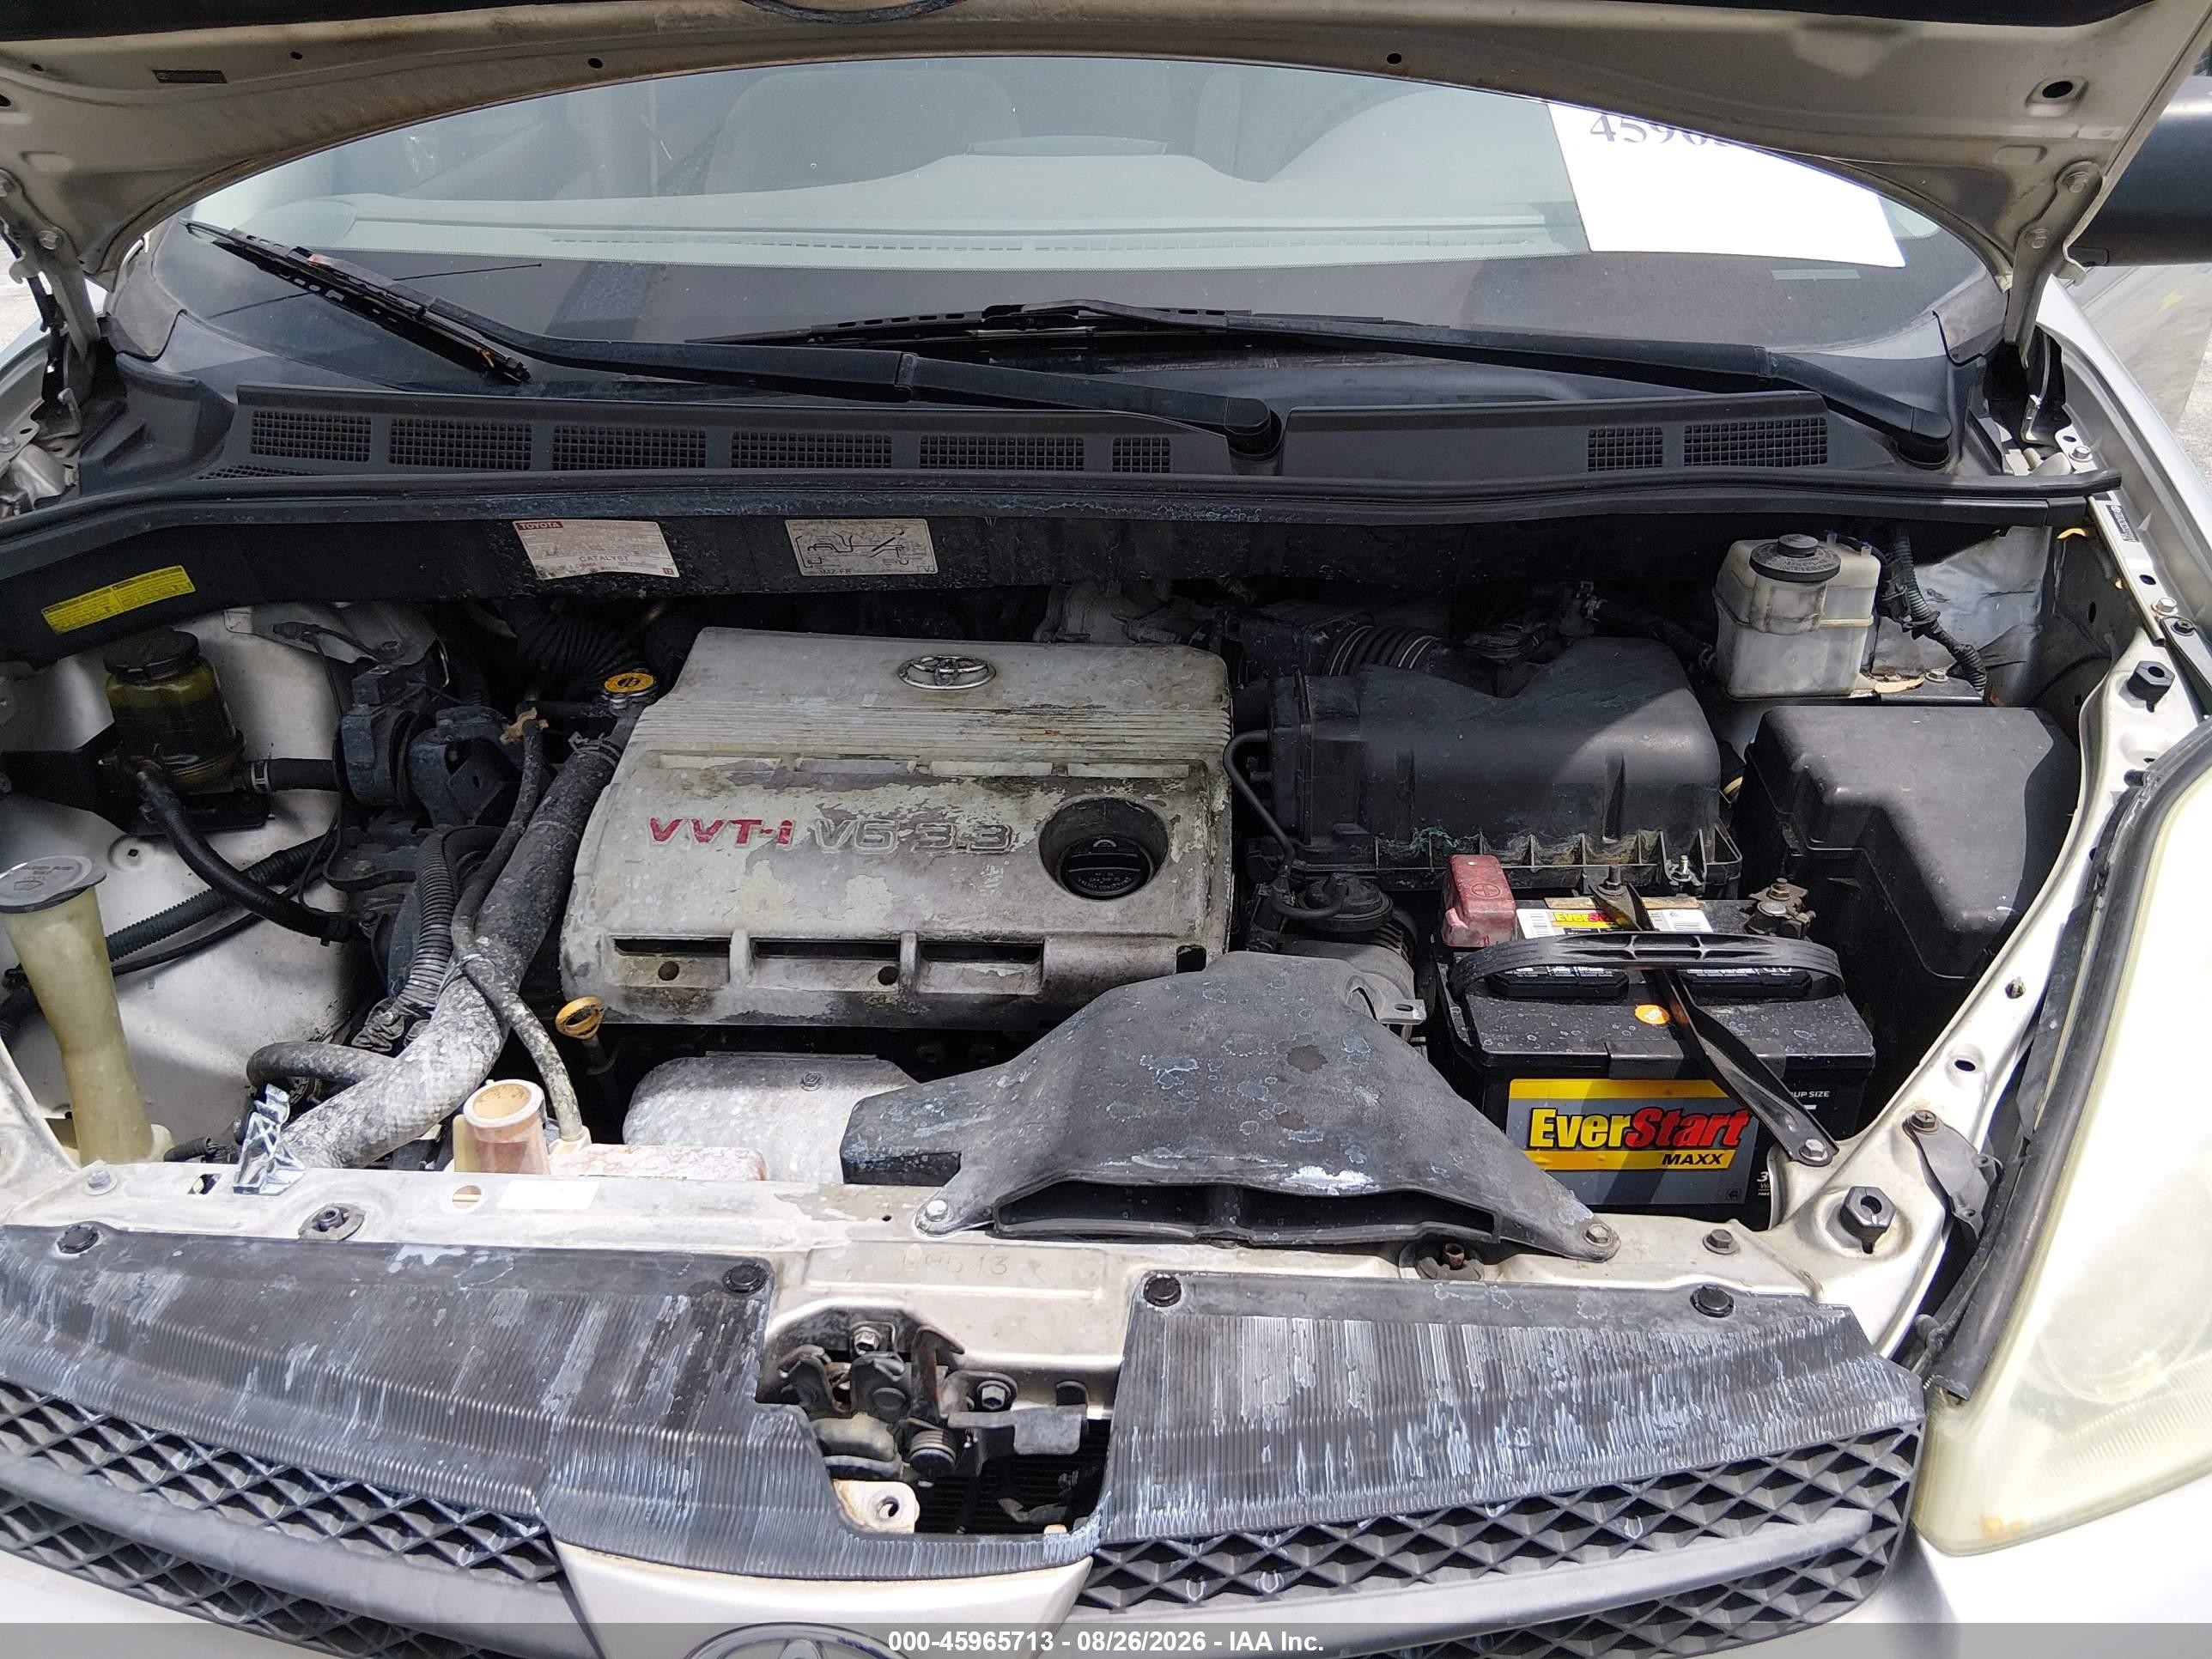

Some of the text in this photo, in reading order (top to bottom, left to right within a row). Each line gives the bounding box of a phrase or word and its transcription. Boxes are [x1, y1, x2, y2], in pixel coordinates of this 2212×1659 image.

[519, 521, 561, 530] TOYOTA
[647, 817, 1014, 854] VVT-i V6 3.3
[1528, 1105, 1752, 1149] EverStart
[1661, 1152, 1725, 1166] MAXX
